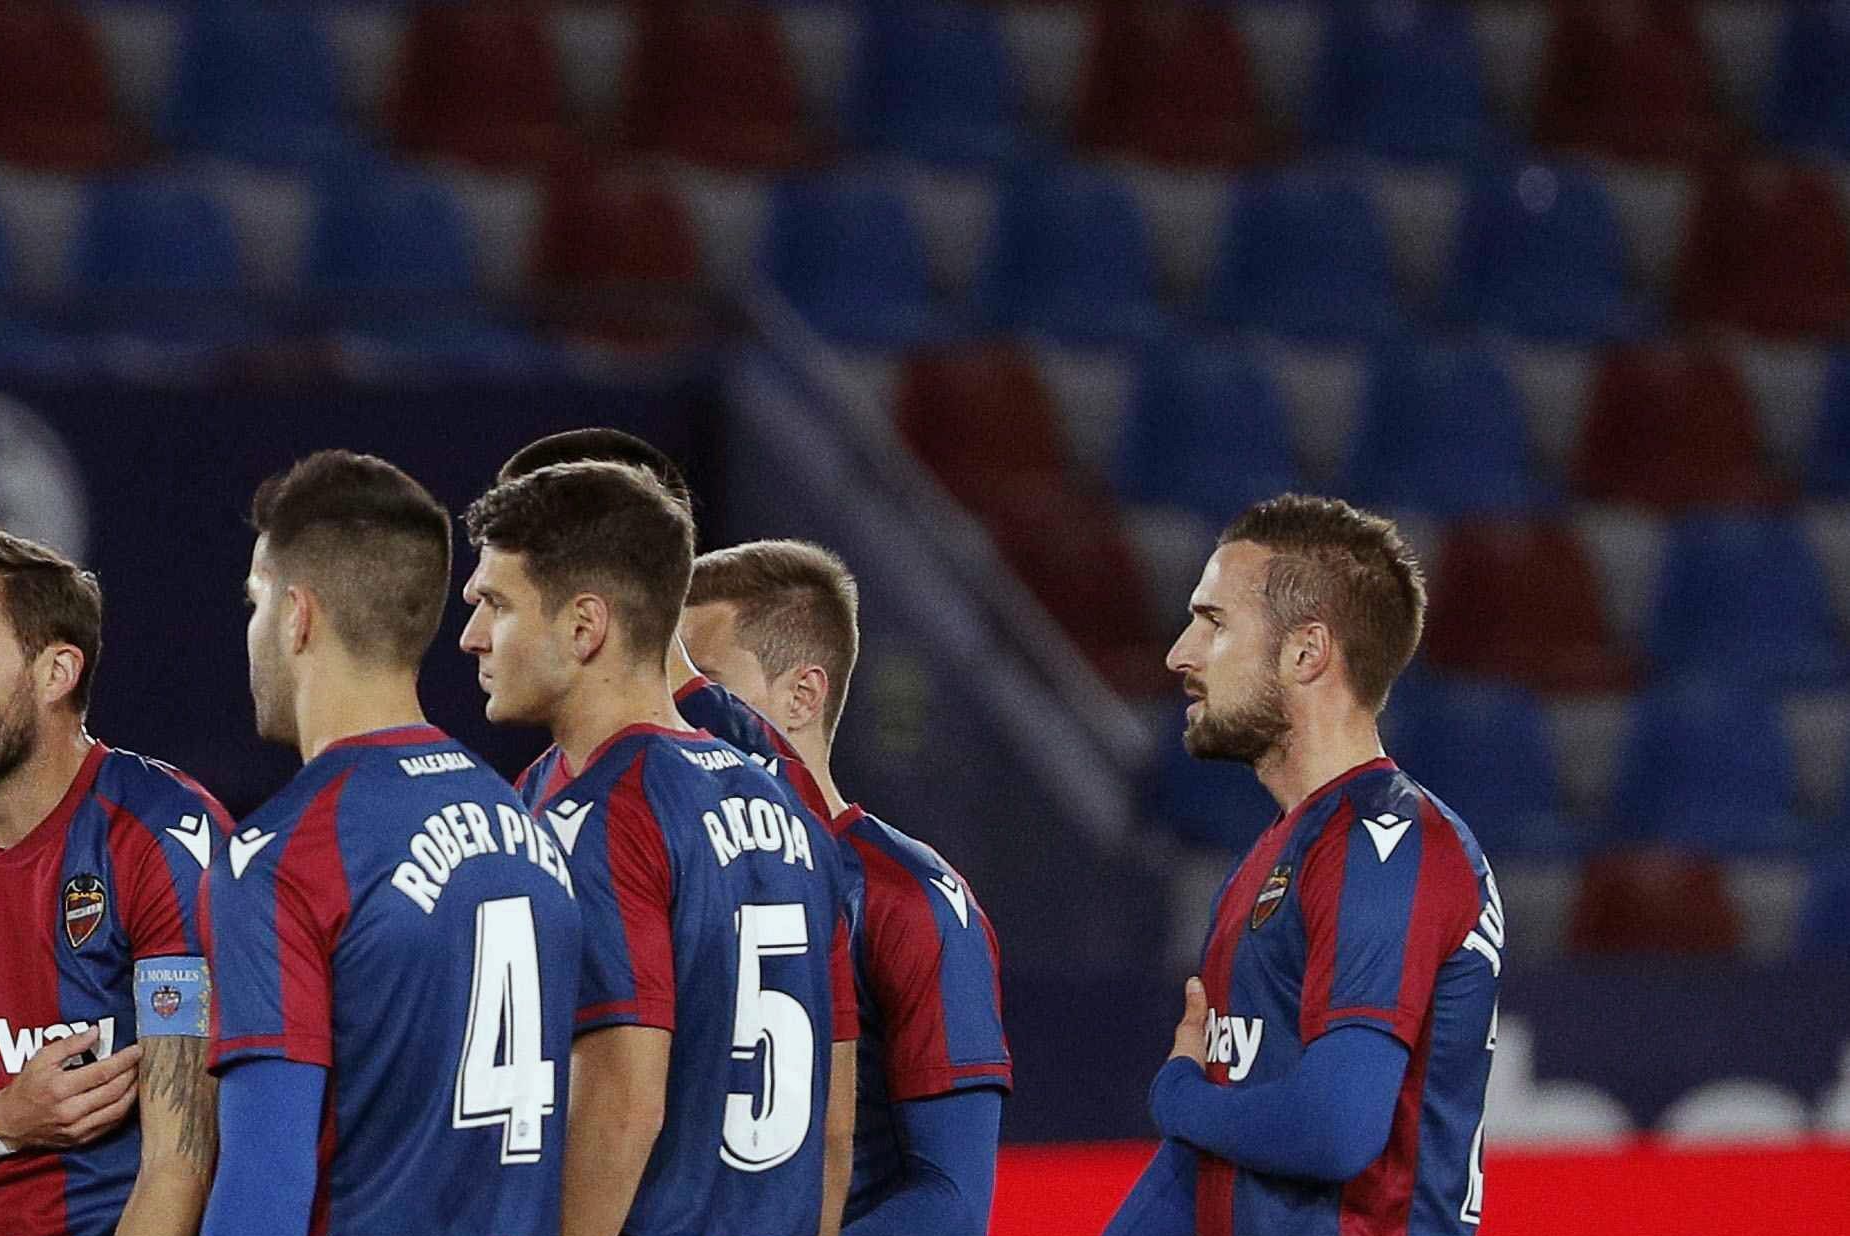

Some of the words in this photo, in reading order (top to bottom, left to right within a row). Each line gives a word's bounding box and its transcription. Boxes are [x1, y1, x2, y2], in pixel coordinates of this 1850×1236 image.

[391, 802, 498, 914] ROBER
[149, 969, 199, 982] MORALES
[452, 896, 555, 1165] 4
[719, 903, 814, 1173] 5
